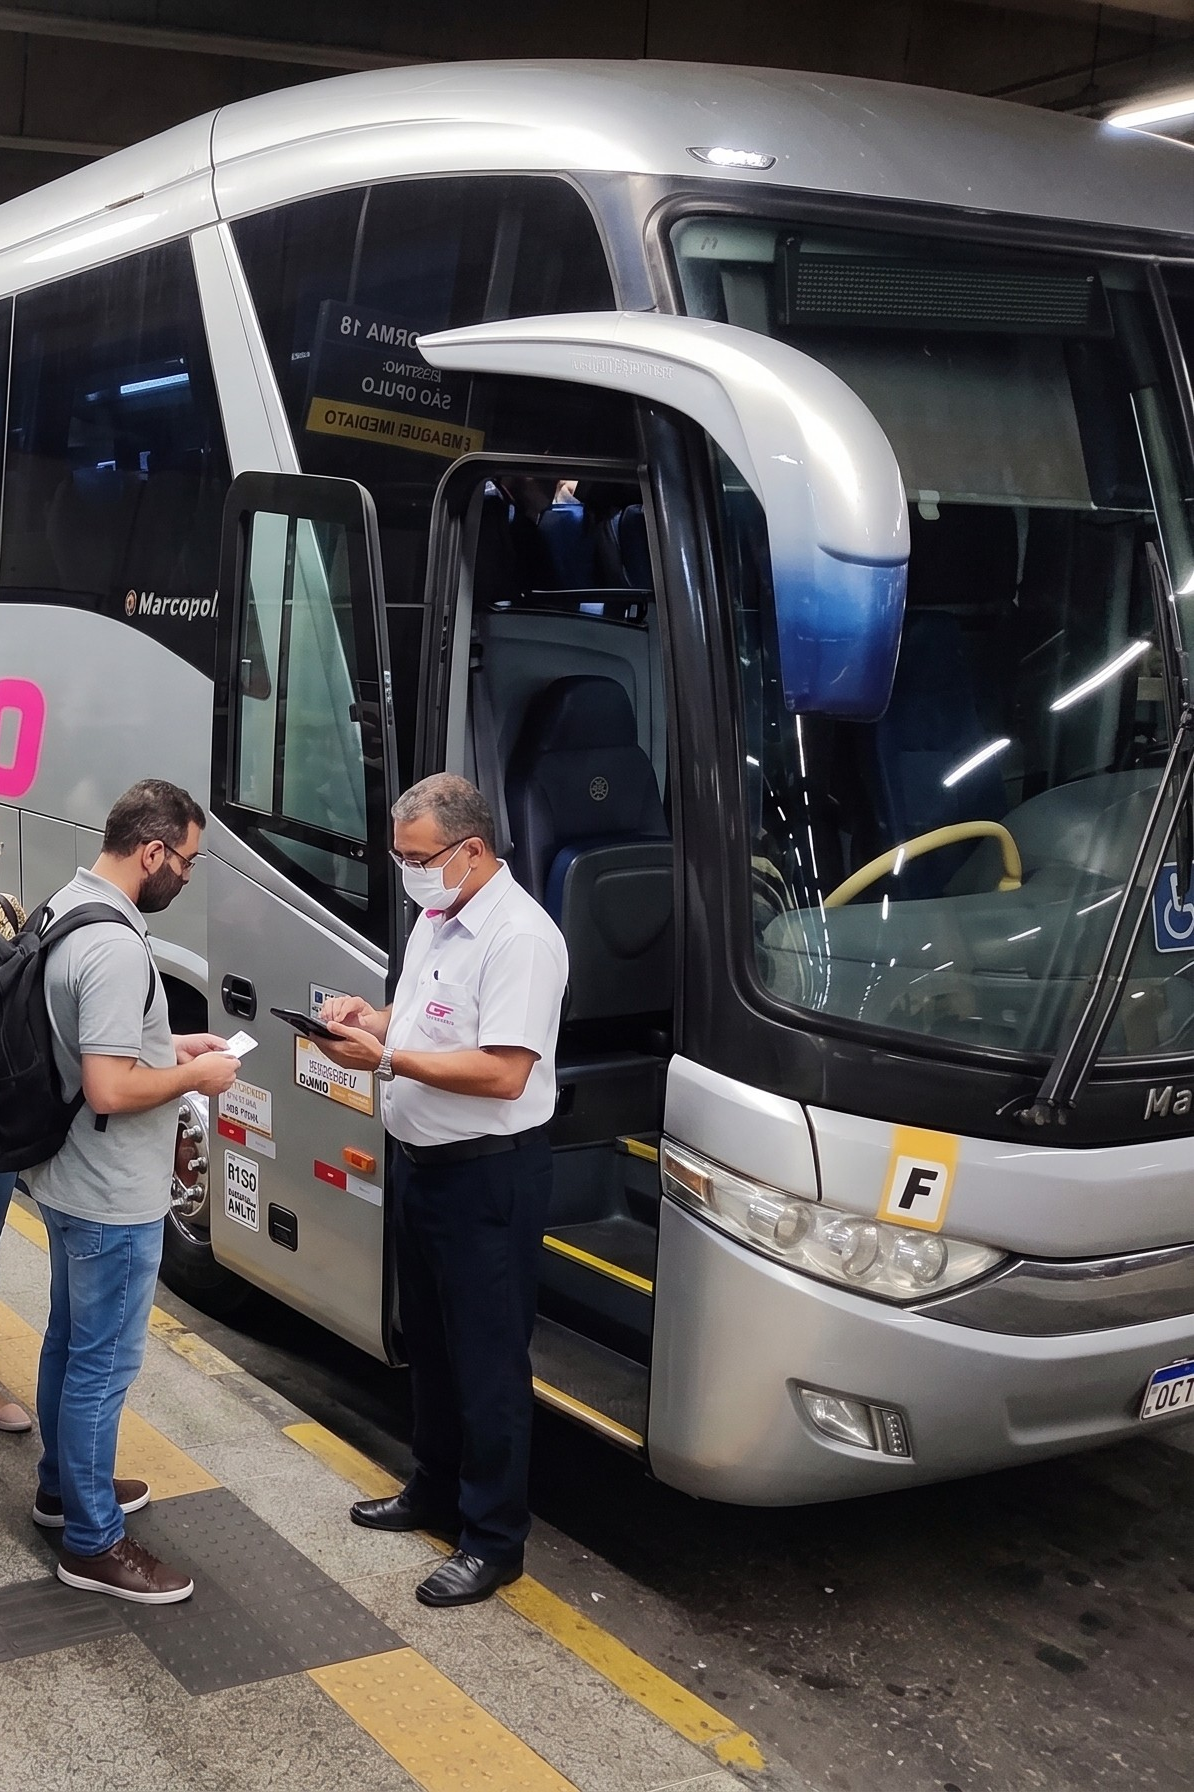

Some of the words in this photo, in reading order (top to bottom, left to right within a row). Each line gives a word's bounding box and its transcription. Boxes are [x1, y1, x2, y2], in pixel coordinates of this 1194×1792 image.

[138, 590, 219, 621] Marcopol
[1144, 1085, 1193, 1120] Ma
[898, 1166, 939, 1210] F
[1154, 1377, 1194, 1411] OCT
